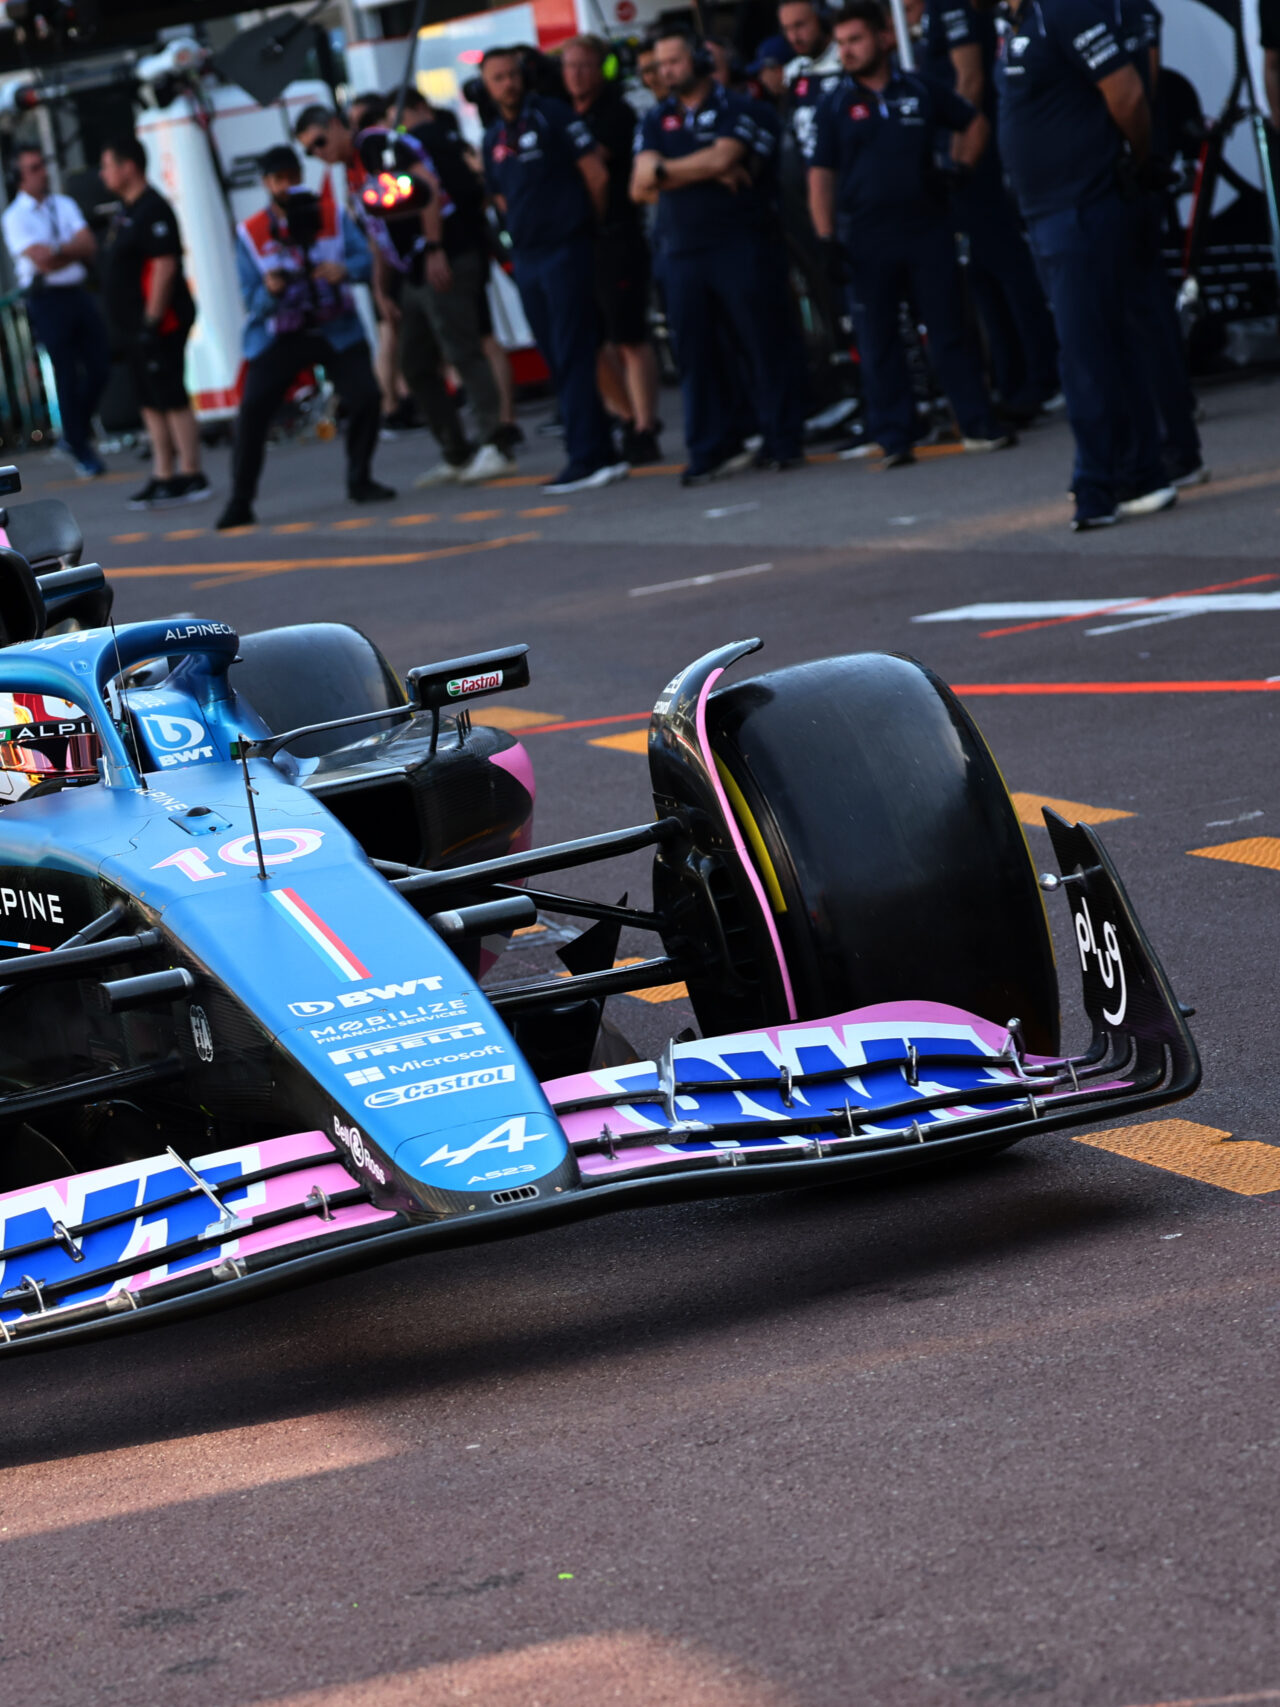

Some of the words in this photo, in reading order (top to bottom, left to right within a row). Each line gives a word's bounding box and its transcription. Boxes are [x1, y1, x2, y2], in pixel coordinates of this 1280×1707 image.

[461, 673, 499, 693] Castrol
[17, 722, 96, 739] ALPI
[158, 746, 213, 767] BWT
[150, 828, 326, 881] 10
[336, 975, 443, 1008] BWT
[317, 1025, 397, 1045] FINANCIAL
[397, 1009, 468, 1027] SERVICES
[328, 1022, 487, 1065] PIRELLI
[388, 1045, 504, 1074] Microsoft
[403, 1068, 510, 1099] Castrol
[333, 1115, 351, 1147] Bell
[364, 1148, 386, 1185] Ross
[467, 1165, 536, 1185] A523
